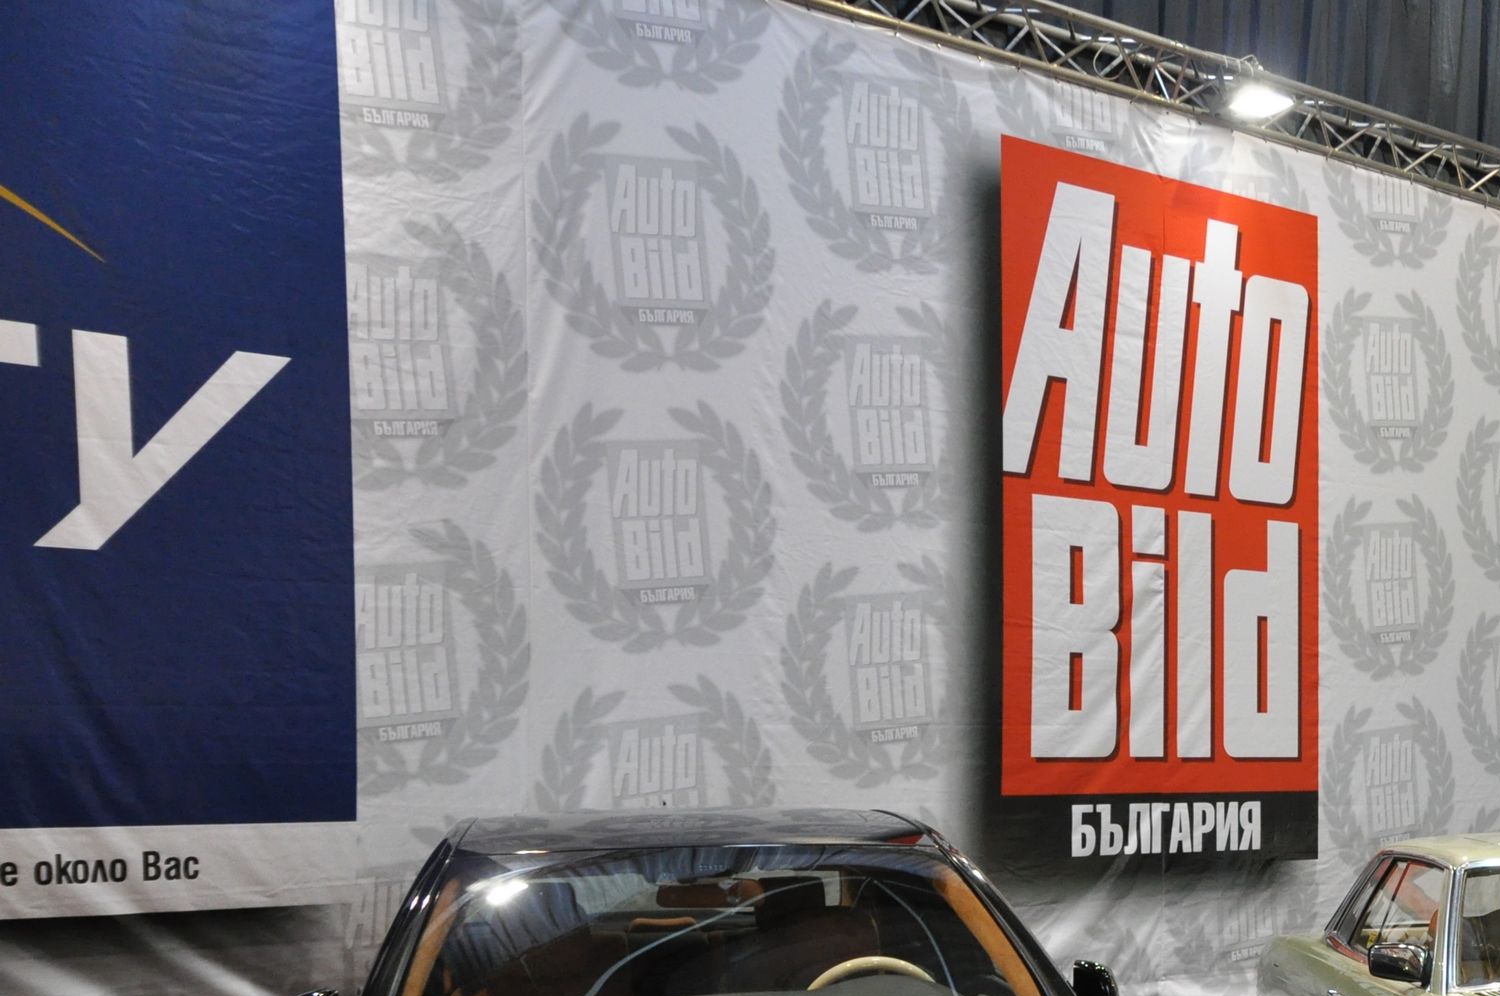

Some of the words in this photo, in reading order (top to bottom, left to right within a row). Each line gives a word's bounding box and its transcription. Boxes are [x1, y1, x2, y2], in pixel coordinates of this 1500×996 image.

[635, 22, 692, 43] БЪЛГАРИЯ
[362, 107, 429, 128] БЪЛГАРИЯ
[848, 81, 919, 150] Auto
[612, 165, 696, 236] Auto
[856, 148, 925, 209] Bild
[620, 236, 703, 301] Bild
[639, 308, 694, 324] БЪЛГАРИЯ
[1002, 181, 1309, 505] Auto
[352, 344, 448, 411] Bild
[849, 343, 921, 408] Auto
[1366, 322, 1412, 375] Auto
[1370, 375, 1416, 421] Bild
[856, 408, 926, 465] Bild
[613, 449, 697, 519] Auto
[622, 517, 704, 580] Bild
[1367, 530, 1412, 580] Auto
[640, 586, 695, 603] БЪЛГАРИЯ
[1030, 493, 1299, 759] Bild
[1371, 578, 1417, 627] Bild
[850, 600, 921, 666] Auto
[358, 647, 452, 718] Bild
[857, 653, 926, 723] Bild
[614, 725, 697, 797] Auto
[1070, 800, 1262, 858] БЪЛГАРИЯ
[34, 853, 128, 886] около
[142, 851, 200, 881] Вас
